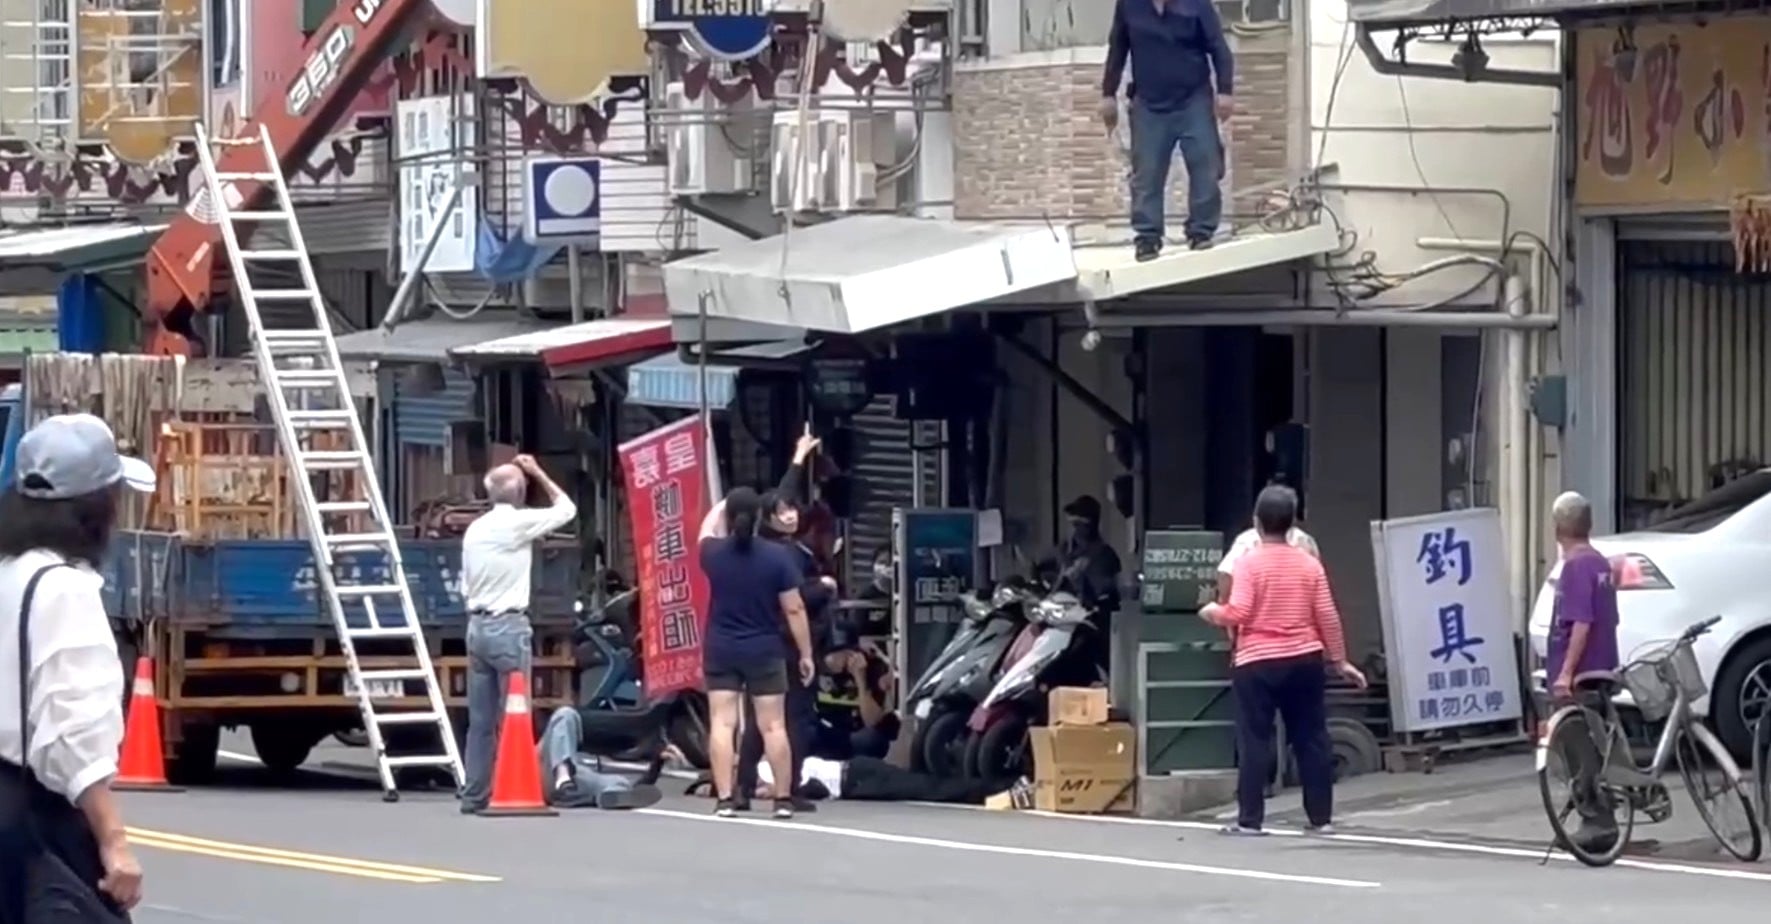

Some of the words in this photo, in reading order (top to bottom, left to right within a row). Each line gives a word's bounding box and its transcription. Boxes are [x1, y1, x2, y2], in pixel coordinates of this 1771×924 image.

[1583, 34, 1771, 185] 旭野小
[1416, 526, 1485, 664] 釣具
[1418, 690, 1505, 720] 請勿久停
[1427, 665, 1490, 691] 車庫前
